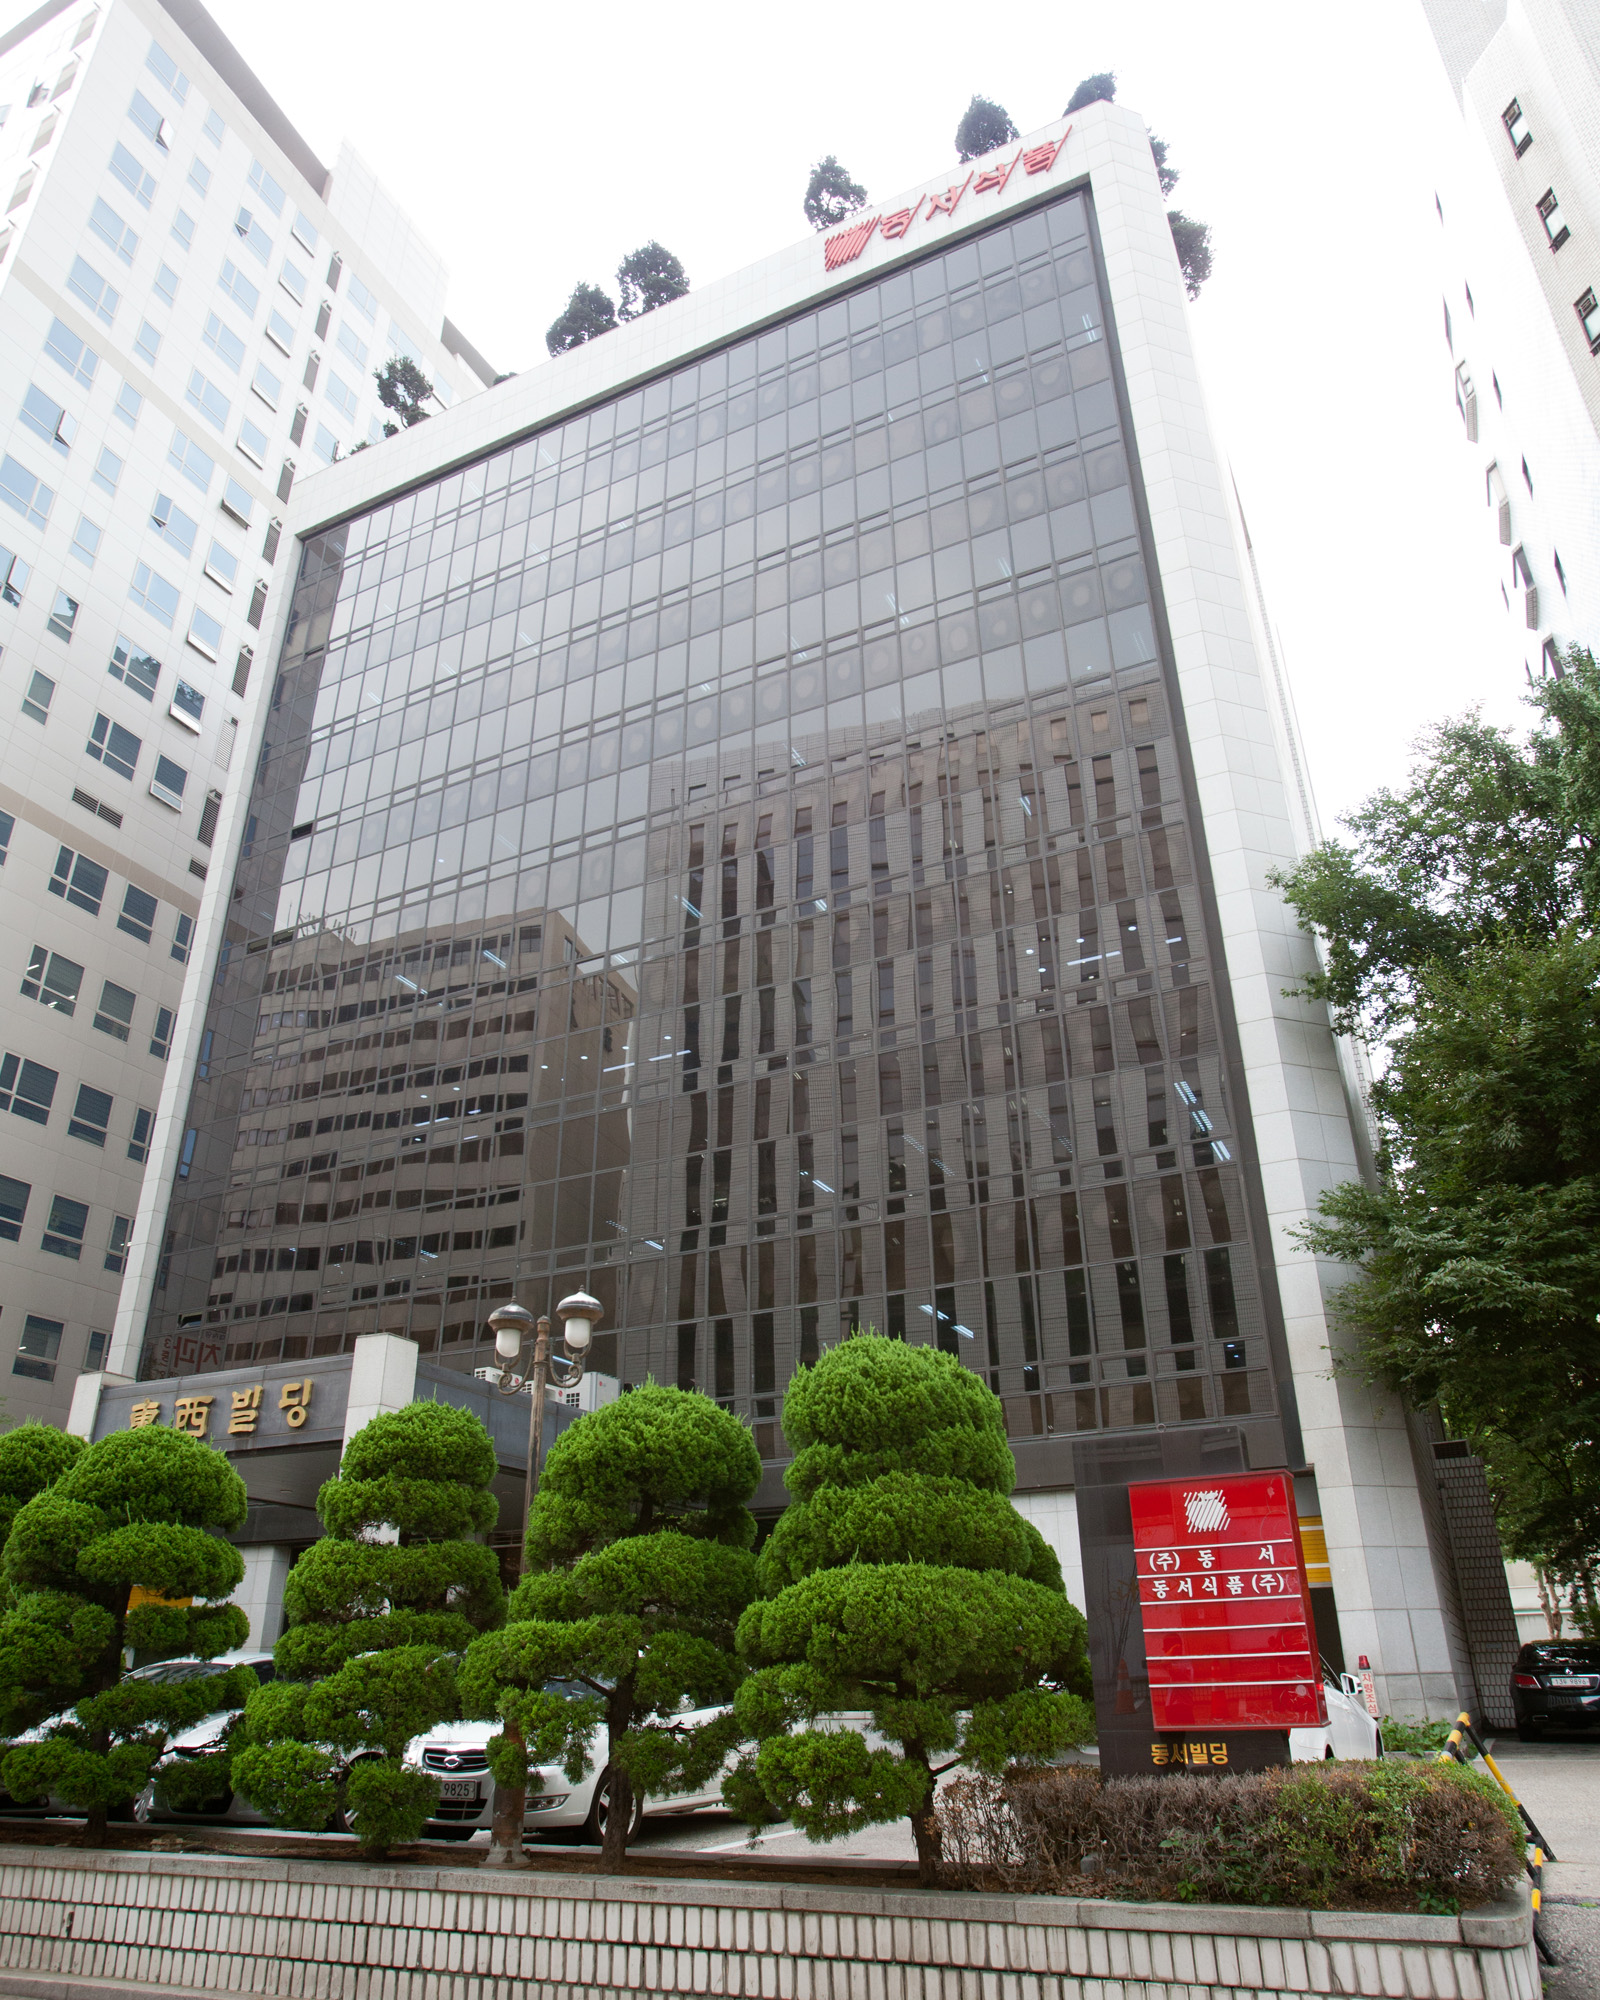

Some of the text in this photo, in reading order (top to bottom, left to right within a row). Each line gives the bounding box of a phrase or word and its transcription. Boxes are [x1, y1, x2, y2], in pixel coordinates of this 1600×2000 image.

[1149, 1551, 1181, 1572] (주)
[1151, 1742, 1229, 1766] 동서빌딩
[444, 1782, 470, 1797] 9825
